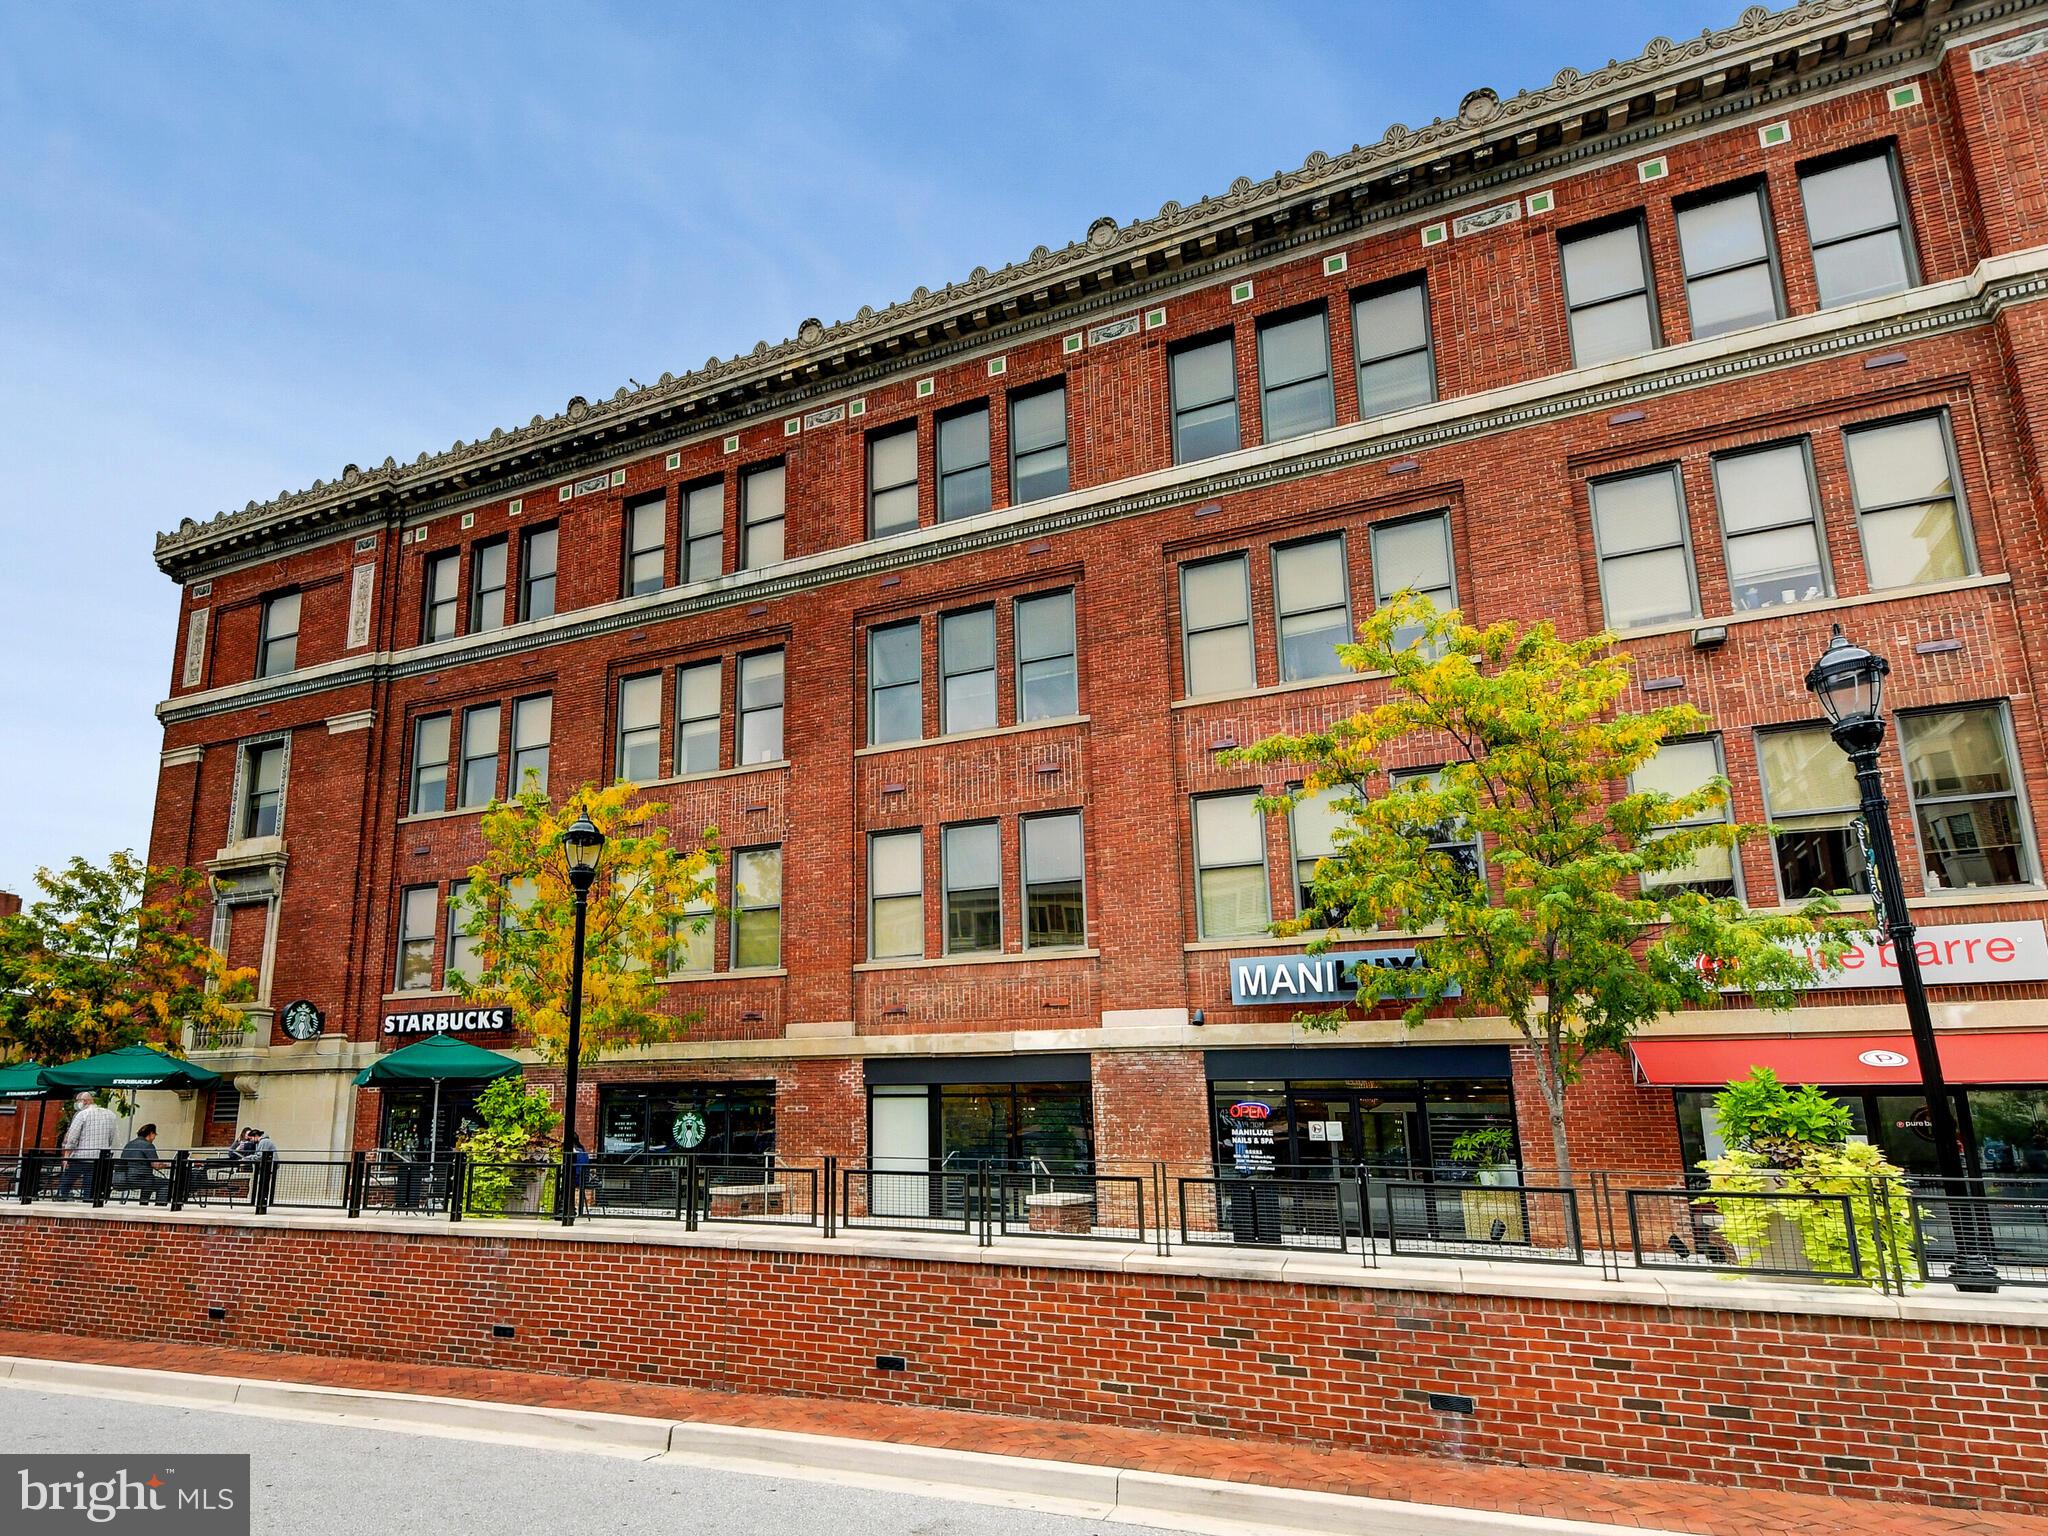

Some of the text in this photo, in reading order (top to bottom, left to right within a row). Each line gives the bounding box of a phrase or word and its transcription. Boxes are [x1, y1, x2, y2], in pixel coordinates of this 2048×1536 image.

[1878, 935, 2016, 968] barre
[1238, 955, 1446, 996] MANIL
[384, 1010, 504, 1033] STARBUCKS
[1230, 1105, 1268, 1119] OPEN
[1231, 1129, 1274, 1137] MANILUXE
